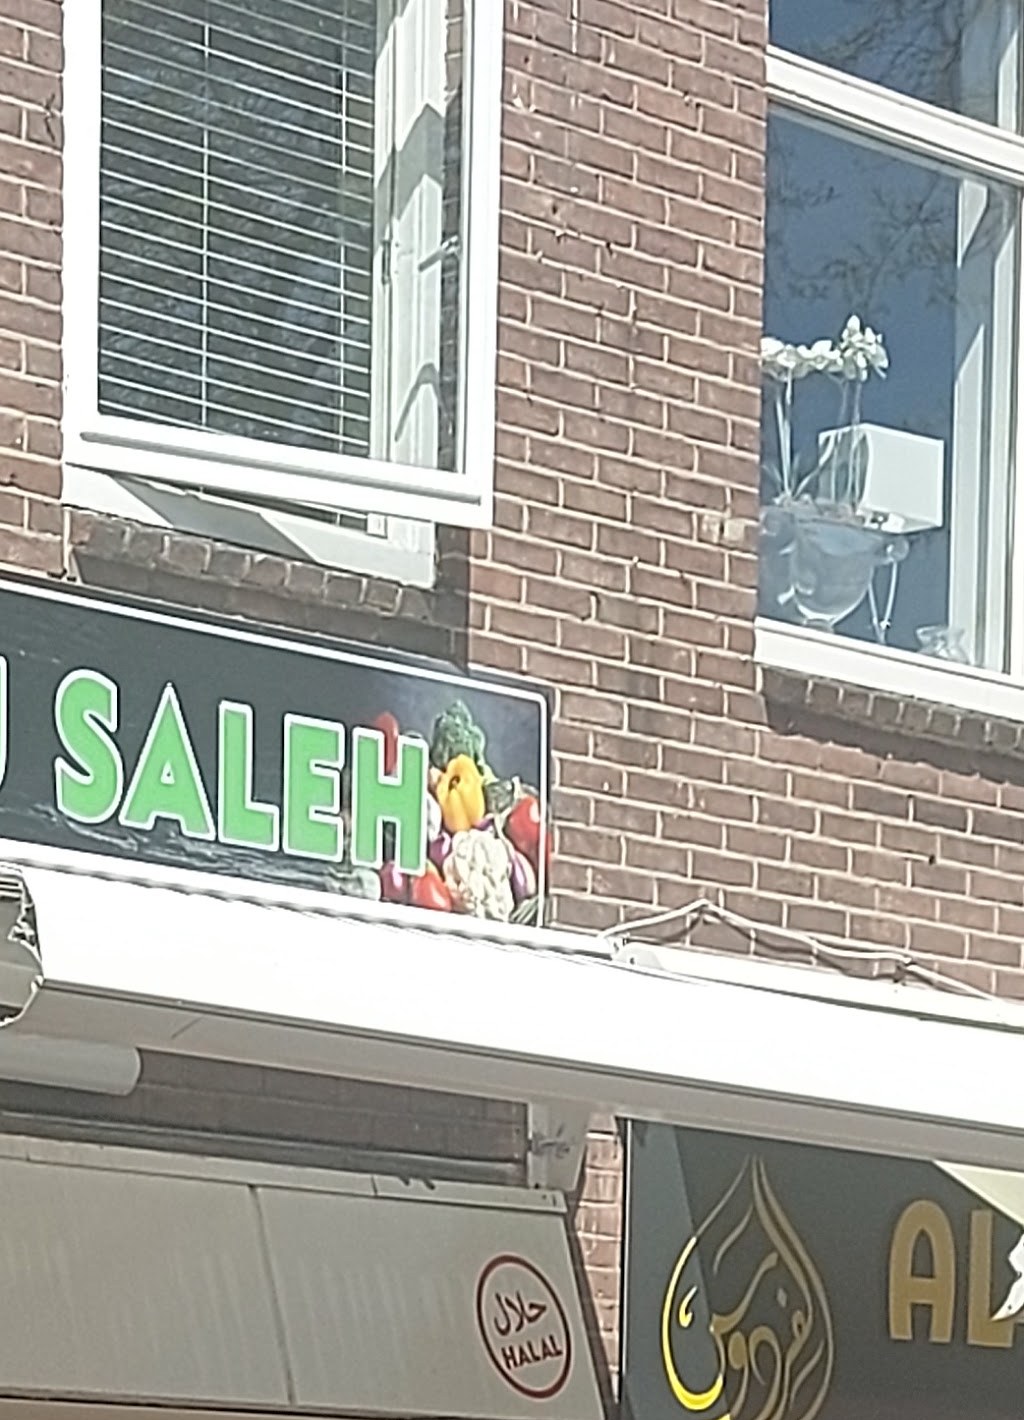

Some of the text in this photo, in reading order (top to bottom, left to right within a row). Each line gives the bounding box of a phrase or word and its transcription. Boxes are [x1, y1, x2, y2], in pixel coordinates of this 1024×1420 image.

[54, 668, 430, 877] SALEH
[493, 1289, 548, 1337] حلال
[888, 1199, 1015, 1349] AL
[500, 1333, 564, 1371] HALAL
